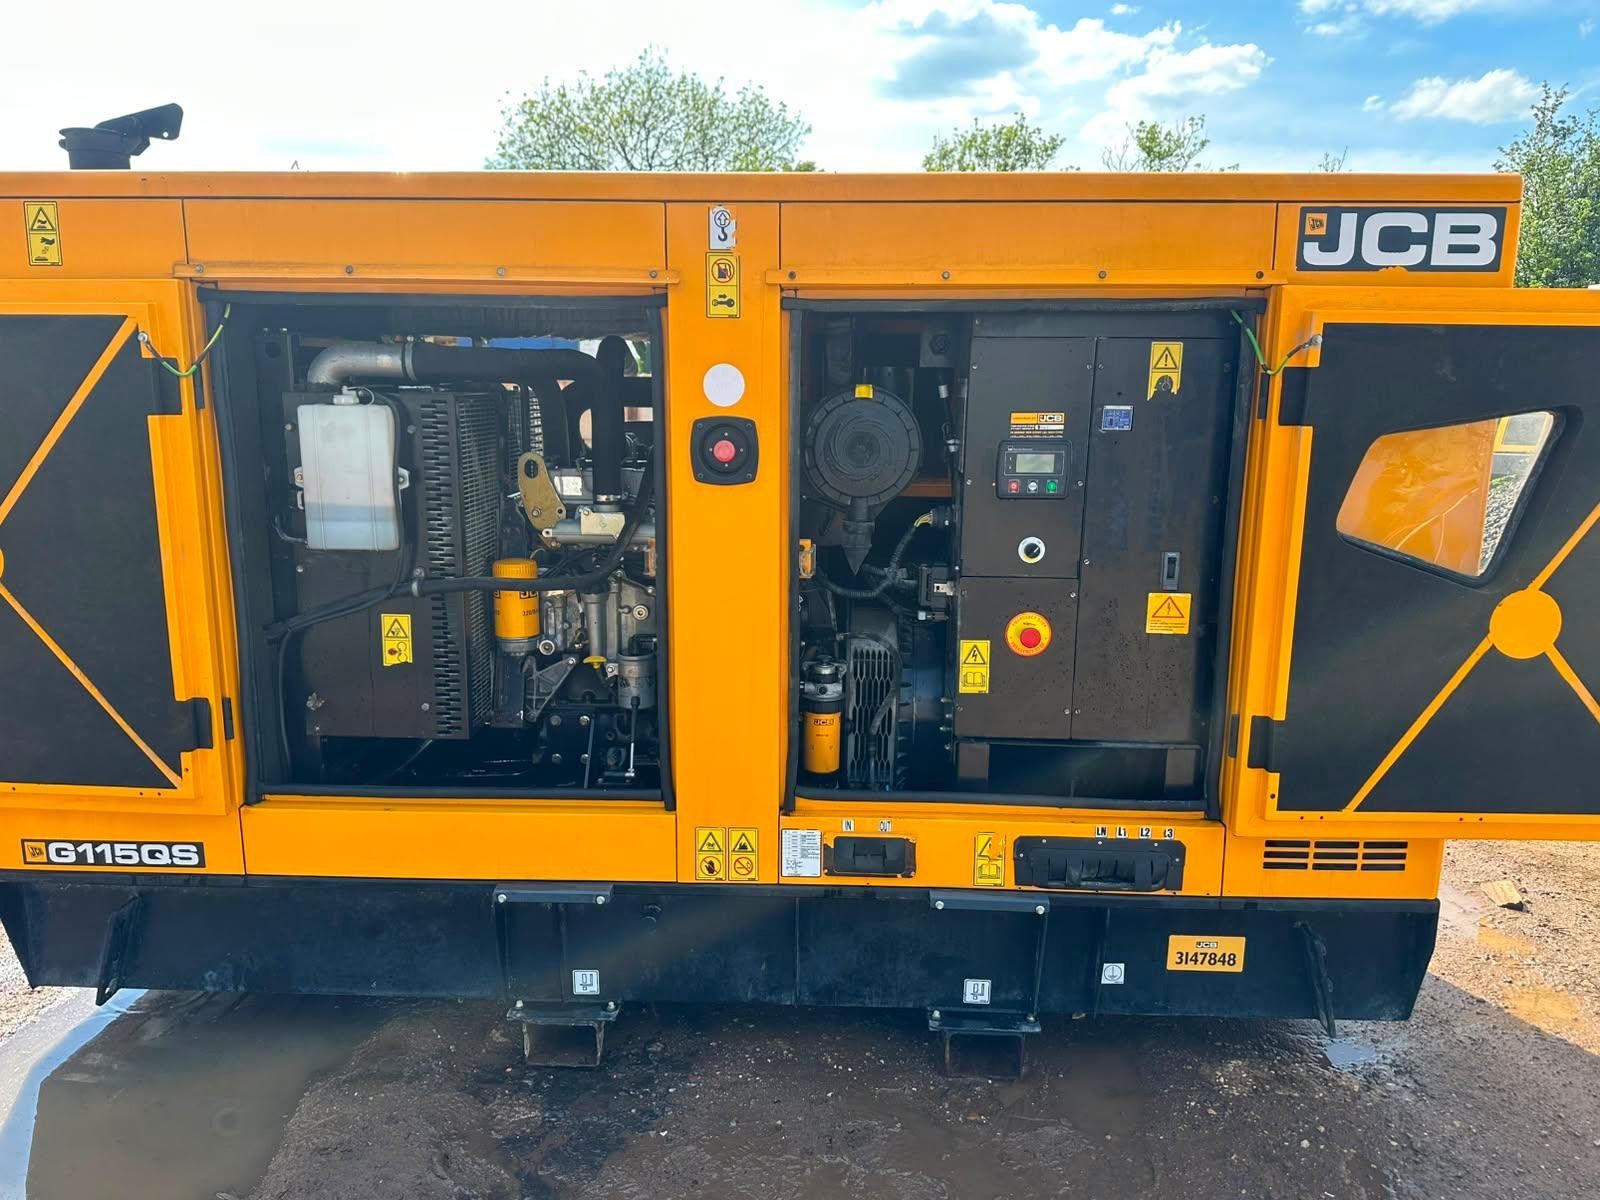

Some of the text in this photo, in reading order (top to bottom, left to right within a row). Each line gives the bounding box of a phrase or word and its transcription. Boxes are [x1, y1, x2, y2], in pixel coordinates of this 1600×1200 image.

[1303, 212, 1498, 266] JCB
[1039, 414, 1063, 422] JCB
[844, 820, 852, 830] IN
[880, 821, 890, 831] OUT
[1097, 826, 1107, 836] LN
[1140, 827, 1150, 837] L2
[48, 842, 199, 865] G115QS
[1175, 951, 1237, 966] 3147848
